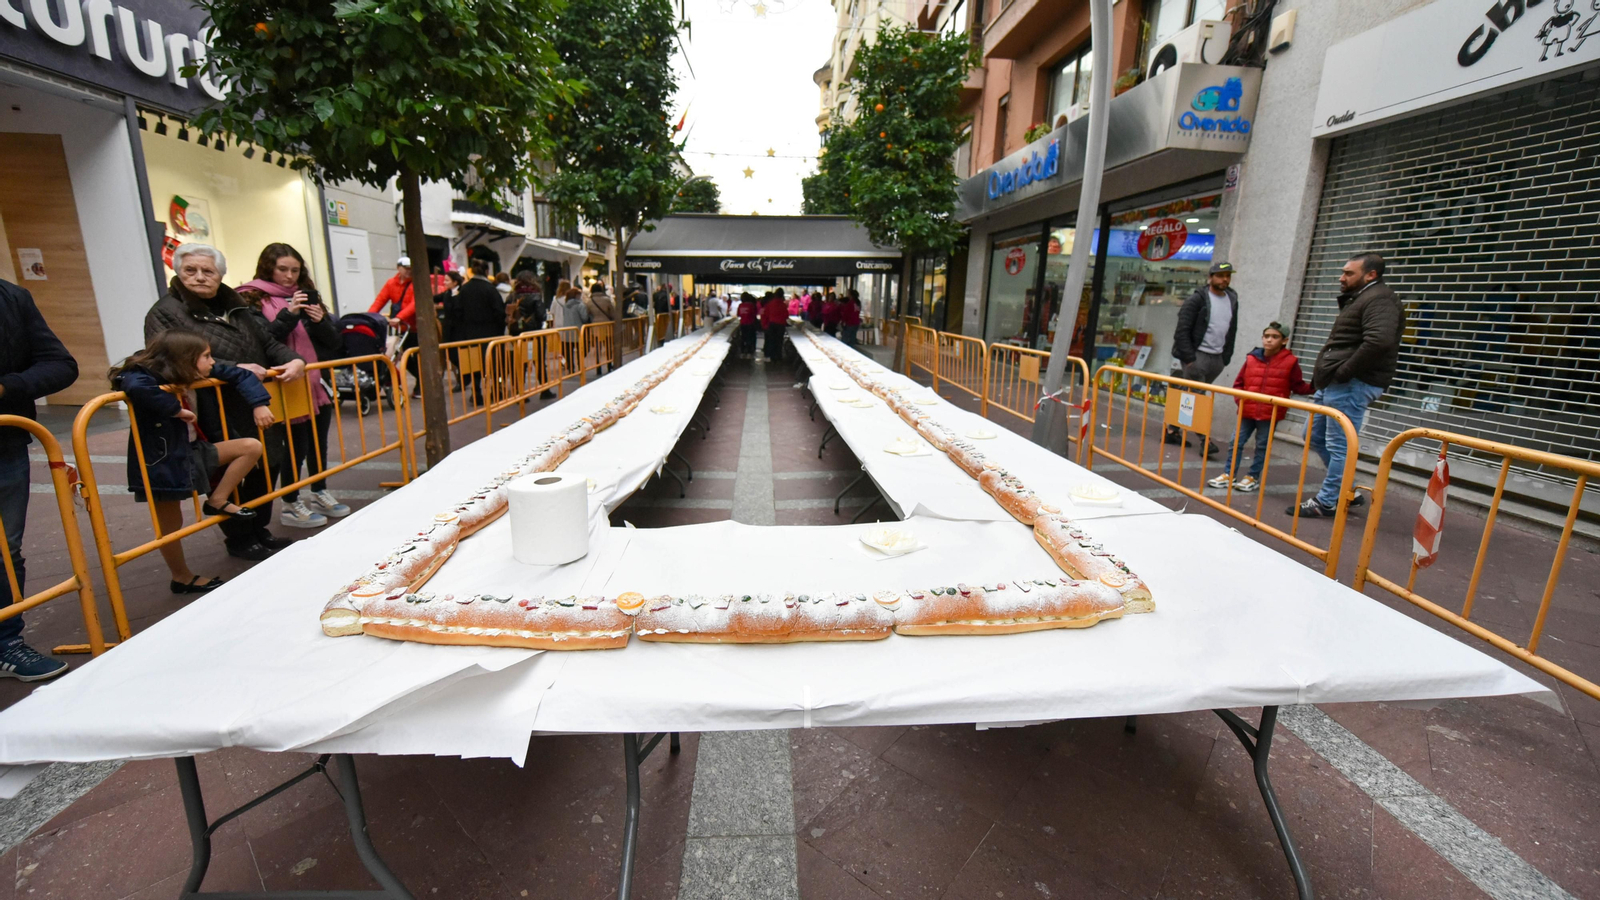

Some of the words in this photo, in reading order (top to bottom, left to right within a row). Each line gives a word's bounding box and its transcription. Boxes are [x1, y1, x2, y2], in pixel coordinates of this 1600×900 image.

[1326, 110, 1356, 127] Outlet
[1144, 221, 1183, 236] REGALO
[624, 260, 662, 269] Cruzcampo
[855, 261, 893, 270] Cruzcampo
